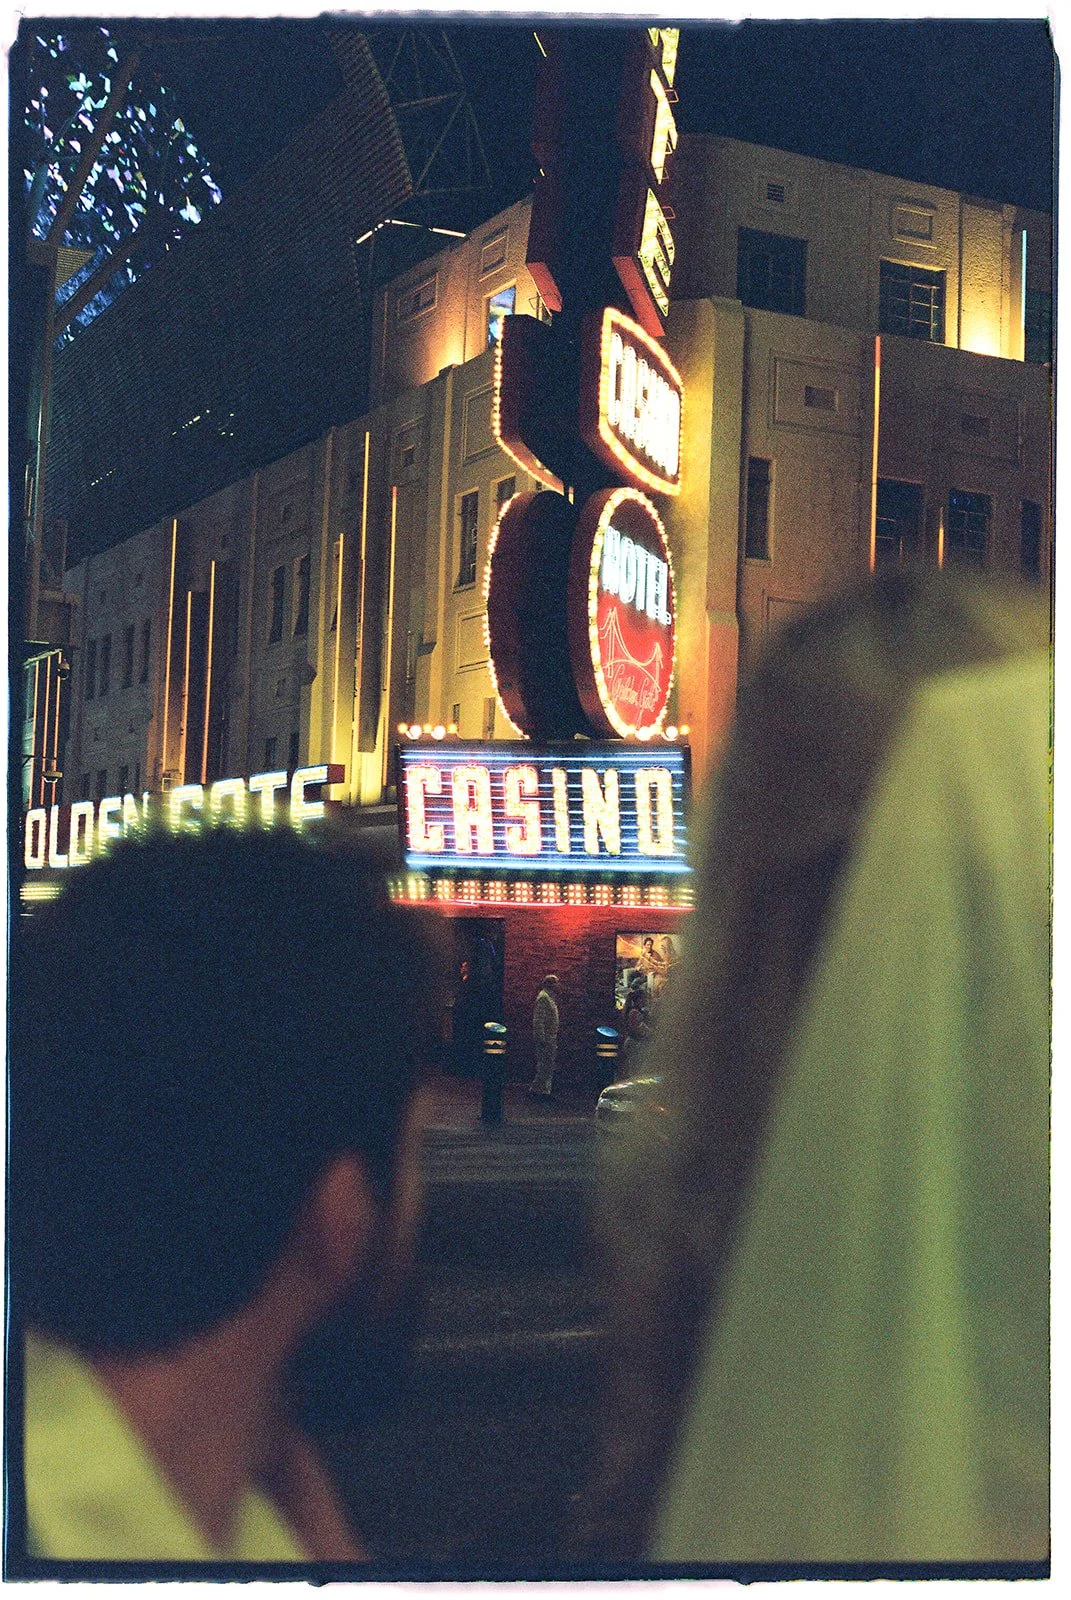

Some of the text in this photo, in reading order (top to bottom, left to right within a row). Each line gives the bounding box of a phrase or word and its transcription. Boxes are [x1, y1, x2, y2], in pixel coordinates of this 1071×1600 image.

[602, 525, 672, 627] HOTEL
[168, 764, 329, 834] GATE
[406, 764, 676, 857] CASINO
